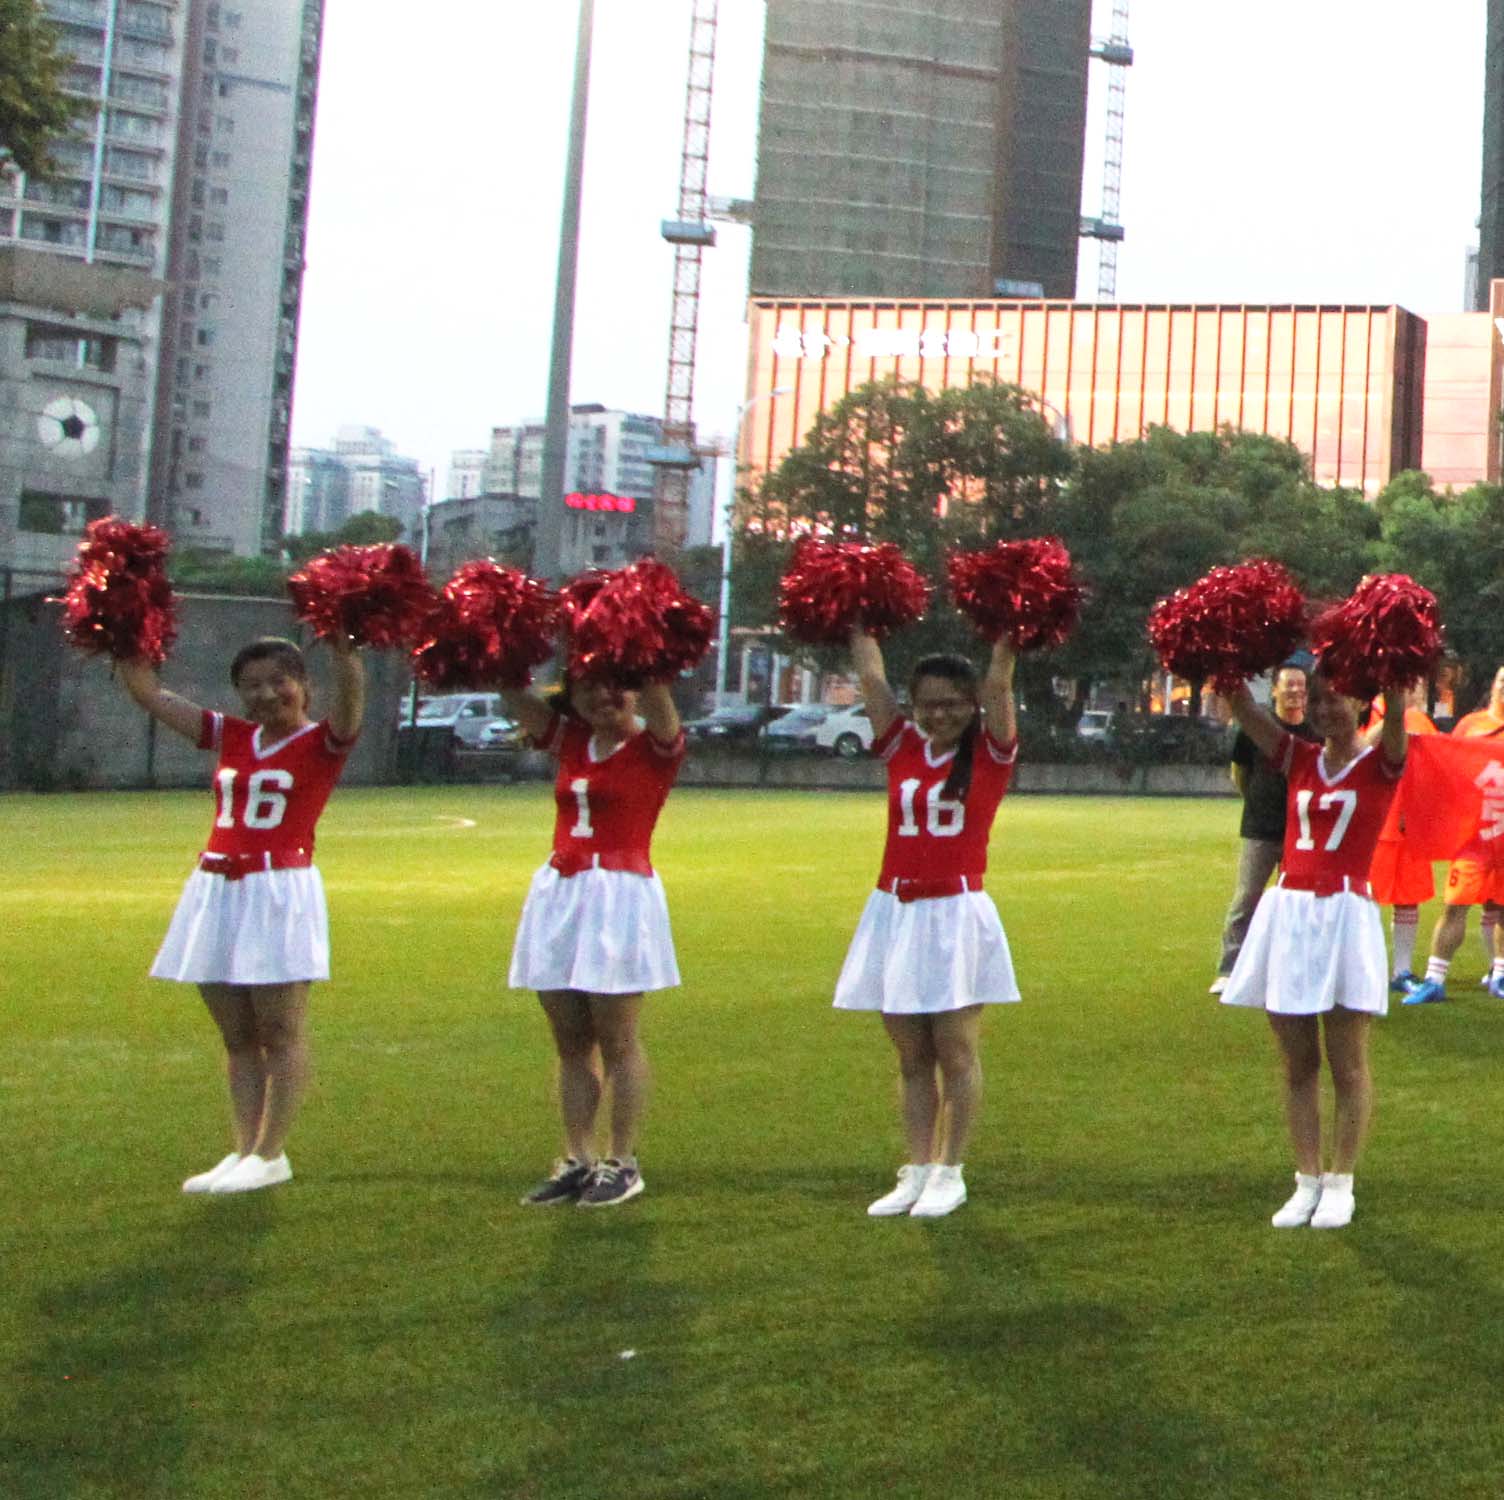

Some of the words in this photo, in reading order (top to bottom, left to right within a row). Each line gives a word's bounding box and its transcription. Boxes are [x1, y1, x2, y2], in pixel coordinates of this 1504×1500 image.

[215, 767, 295, 830] 16
[570, 778, 594, 838] 1
[898, 778, 965, 838] 16
[1296, 789, 1358, 852] 17
